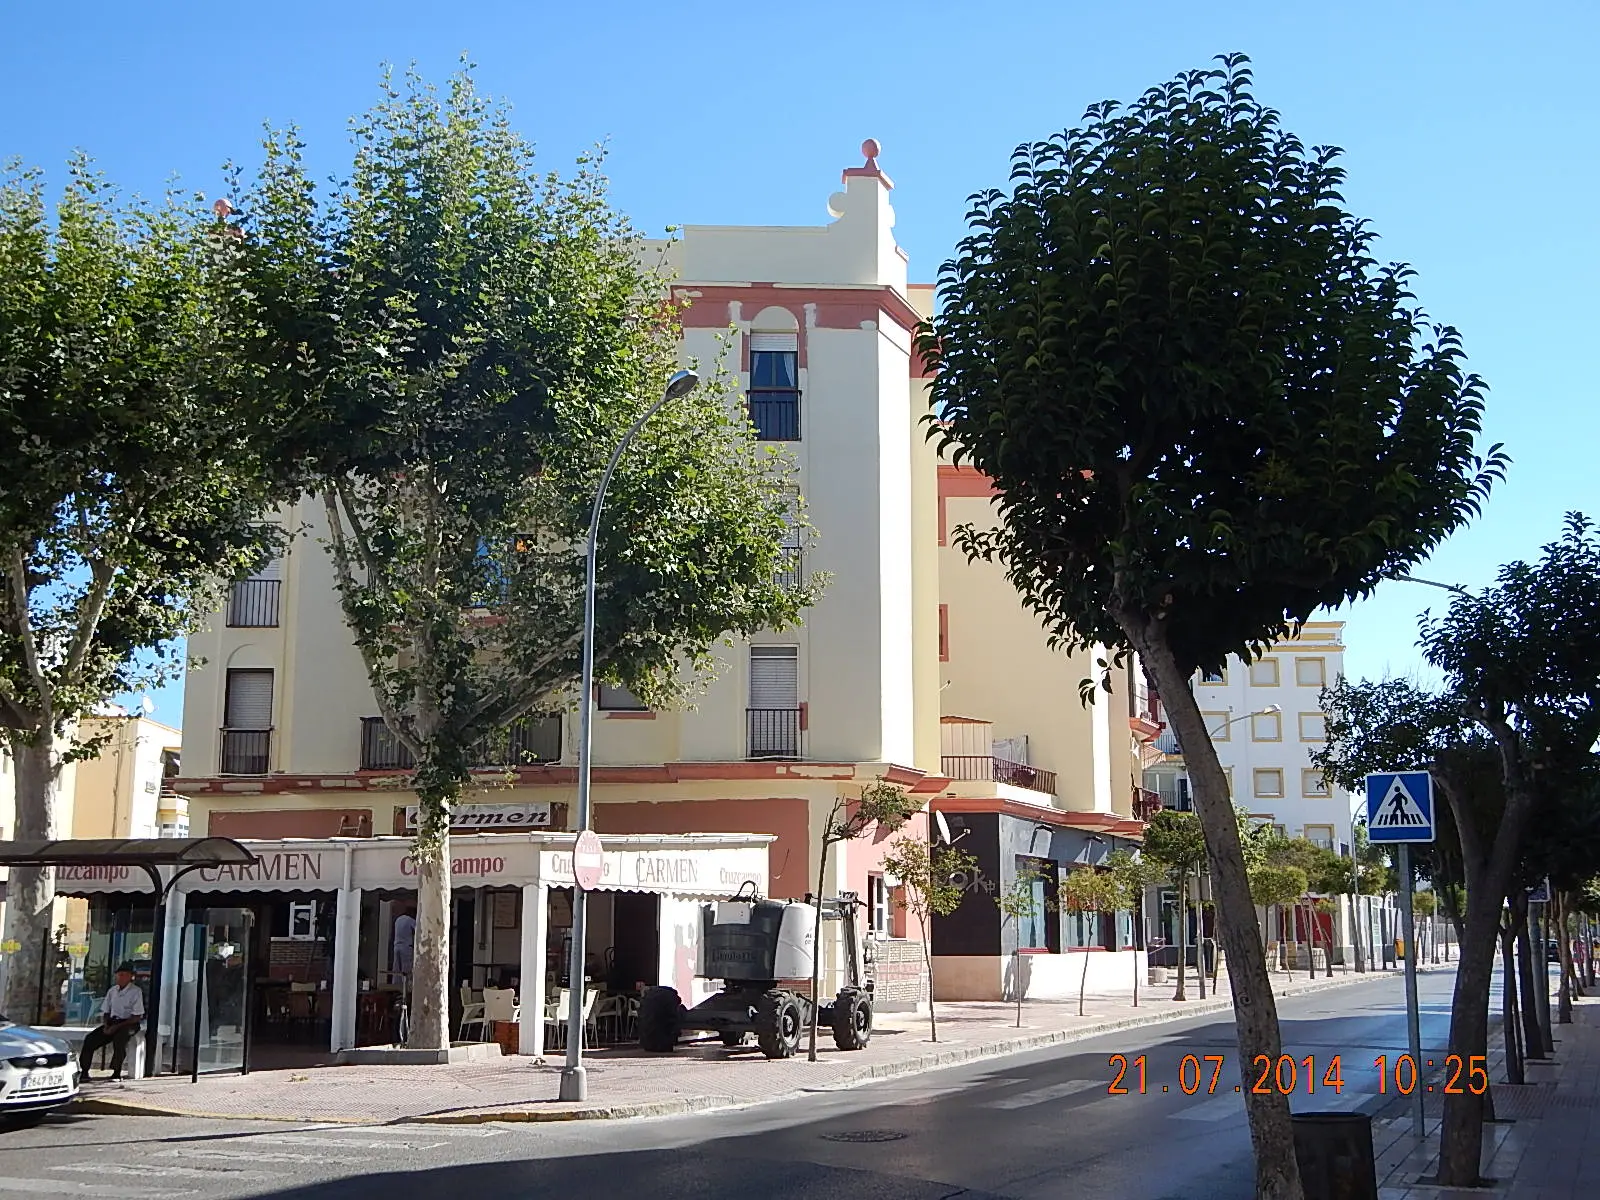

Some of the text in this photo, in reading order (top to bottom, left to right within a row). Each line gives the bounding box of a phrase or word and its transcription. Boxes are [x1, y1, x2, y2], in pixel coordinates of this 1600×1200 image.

[55, 865, 129, 883] uzcampo
[400, 856, 504, 877] Crampo
[636, 858, 698, 883] CARMEN
